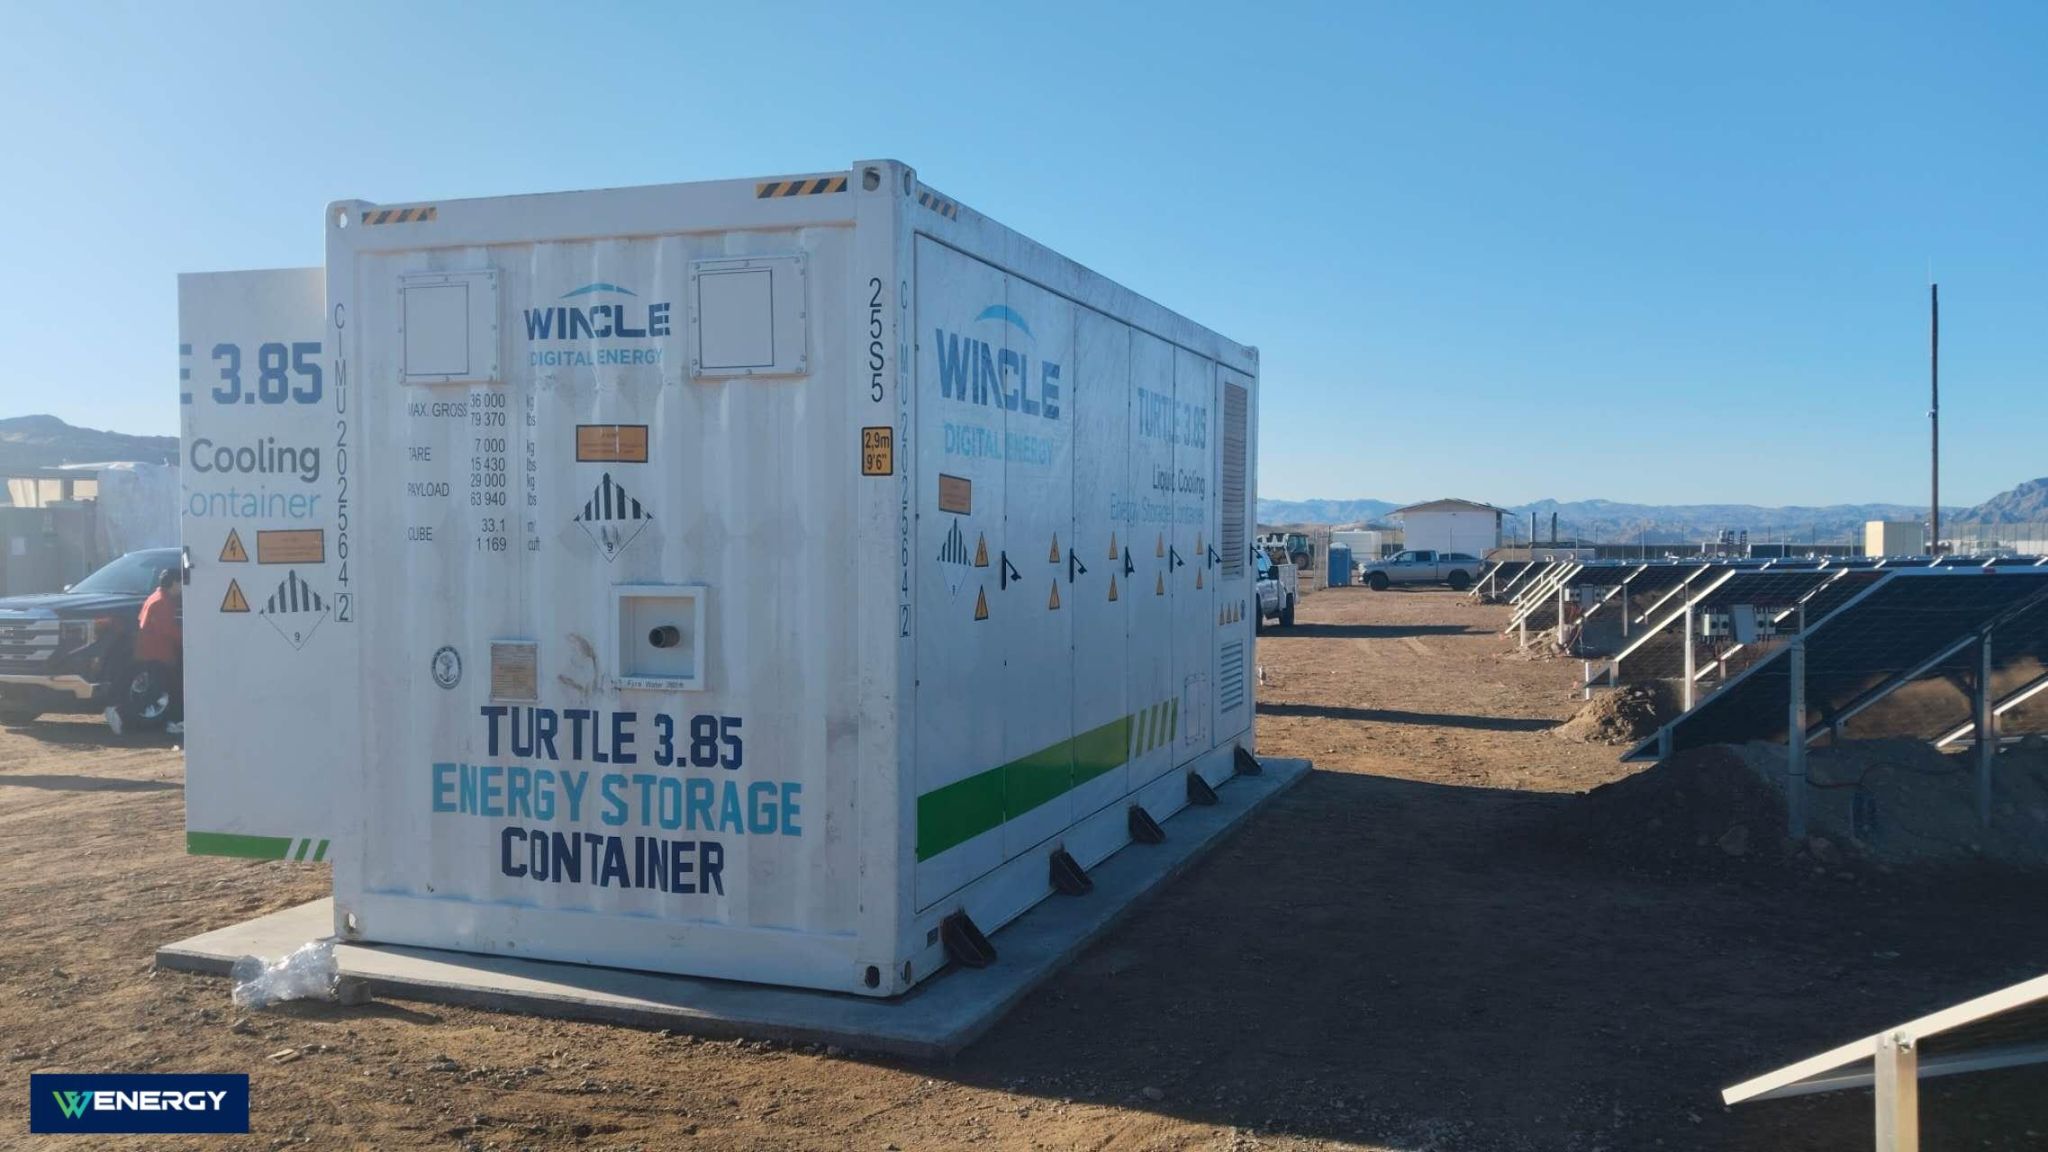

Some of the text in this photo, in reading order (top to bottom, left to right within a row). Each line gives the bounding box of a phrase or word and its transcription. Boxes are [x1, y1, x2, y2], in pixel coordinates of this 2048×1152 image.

[523, 302, 671, 341] WINCLE
[868, 277, 884, 402] 25S5
[211, 342, 323, 405] 3.85
[530, 349, 663, 366] DIGITAL ENERGY
[935, 328, 1061, 420] WINCLE
[189, 436, 320, 483] Cooling
[408, 447, 432, 461] TARE
[943, 422, 1002, 460] DIGITAL
[407, 482, 450, 497] PAYLOAD
[1178, 468, 1205, 500] Cooling
[481, 518, 505, 532] 33.1
[480, 706, 743, 770] TURTLE 3.85
[432, 762, 802, 837] ENERGY STORAGE
[501, 826, 725, 896] CONTAINER
